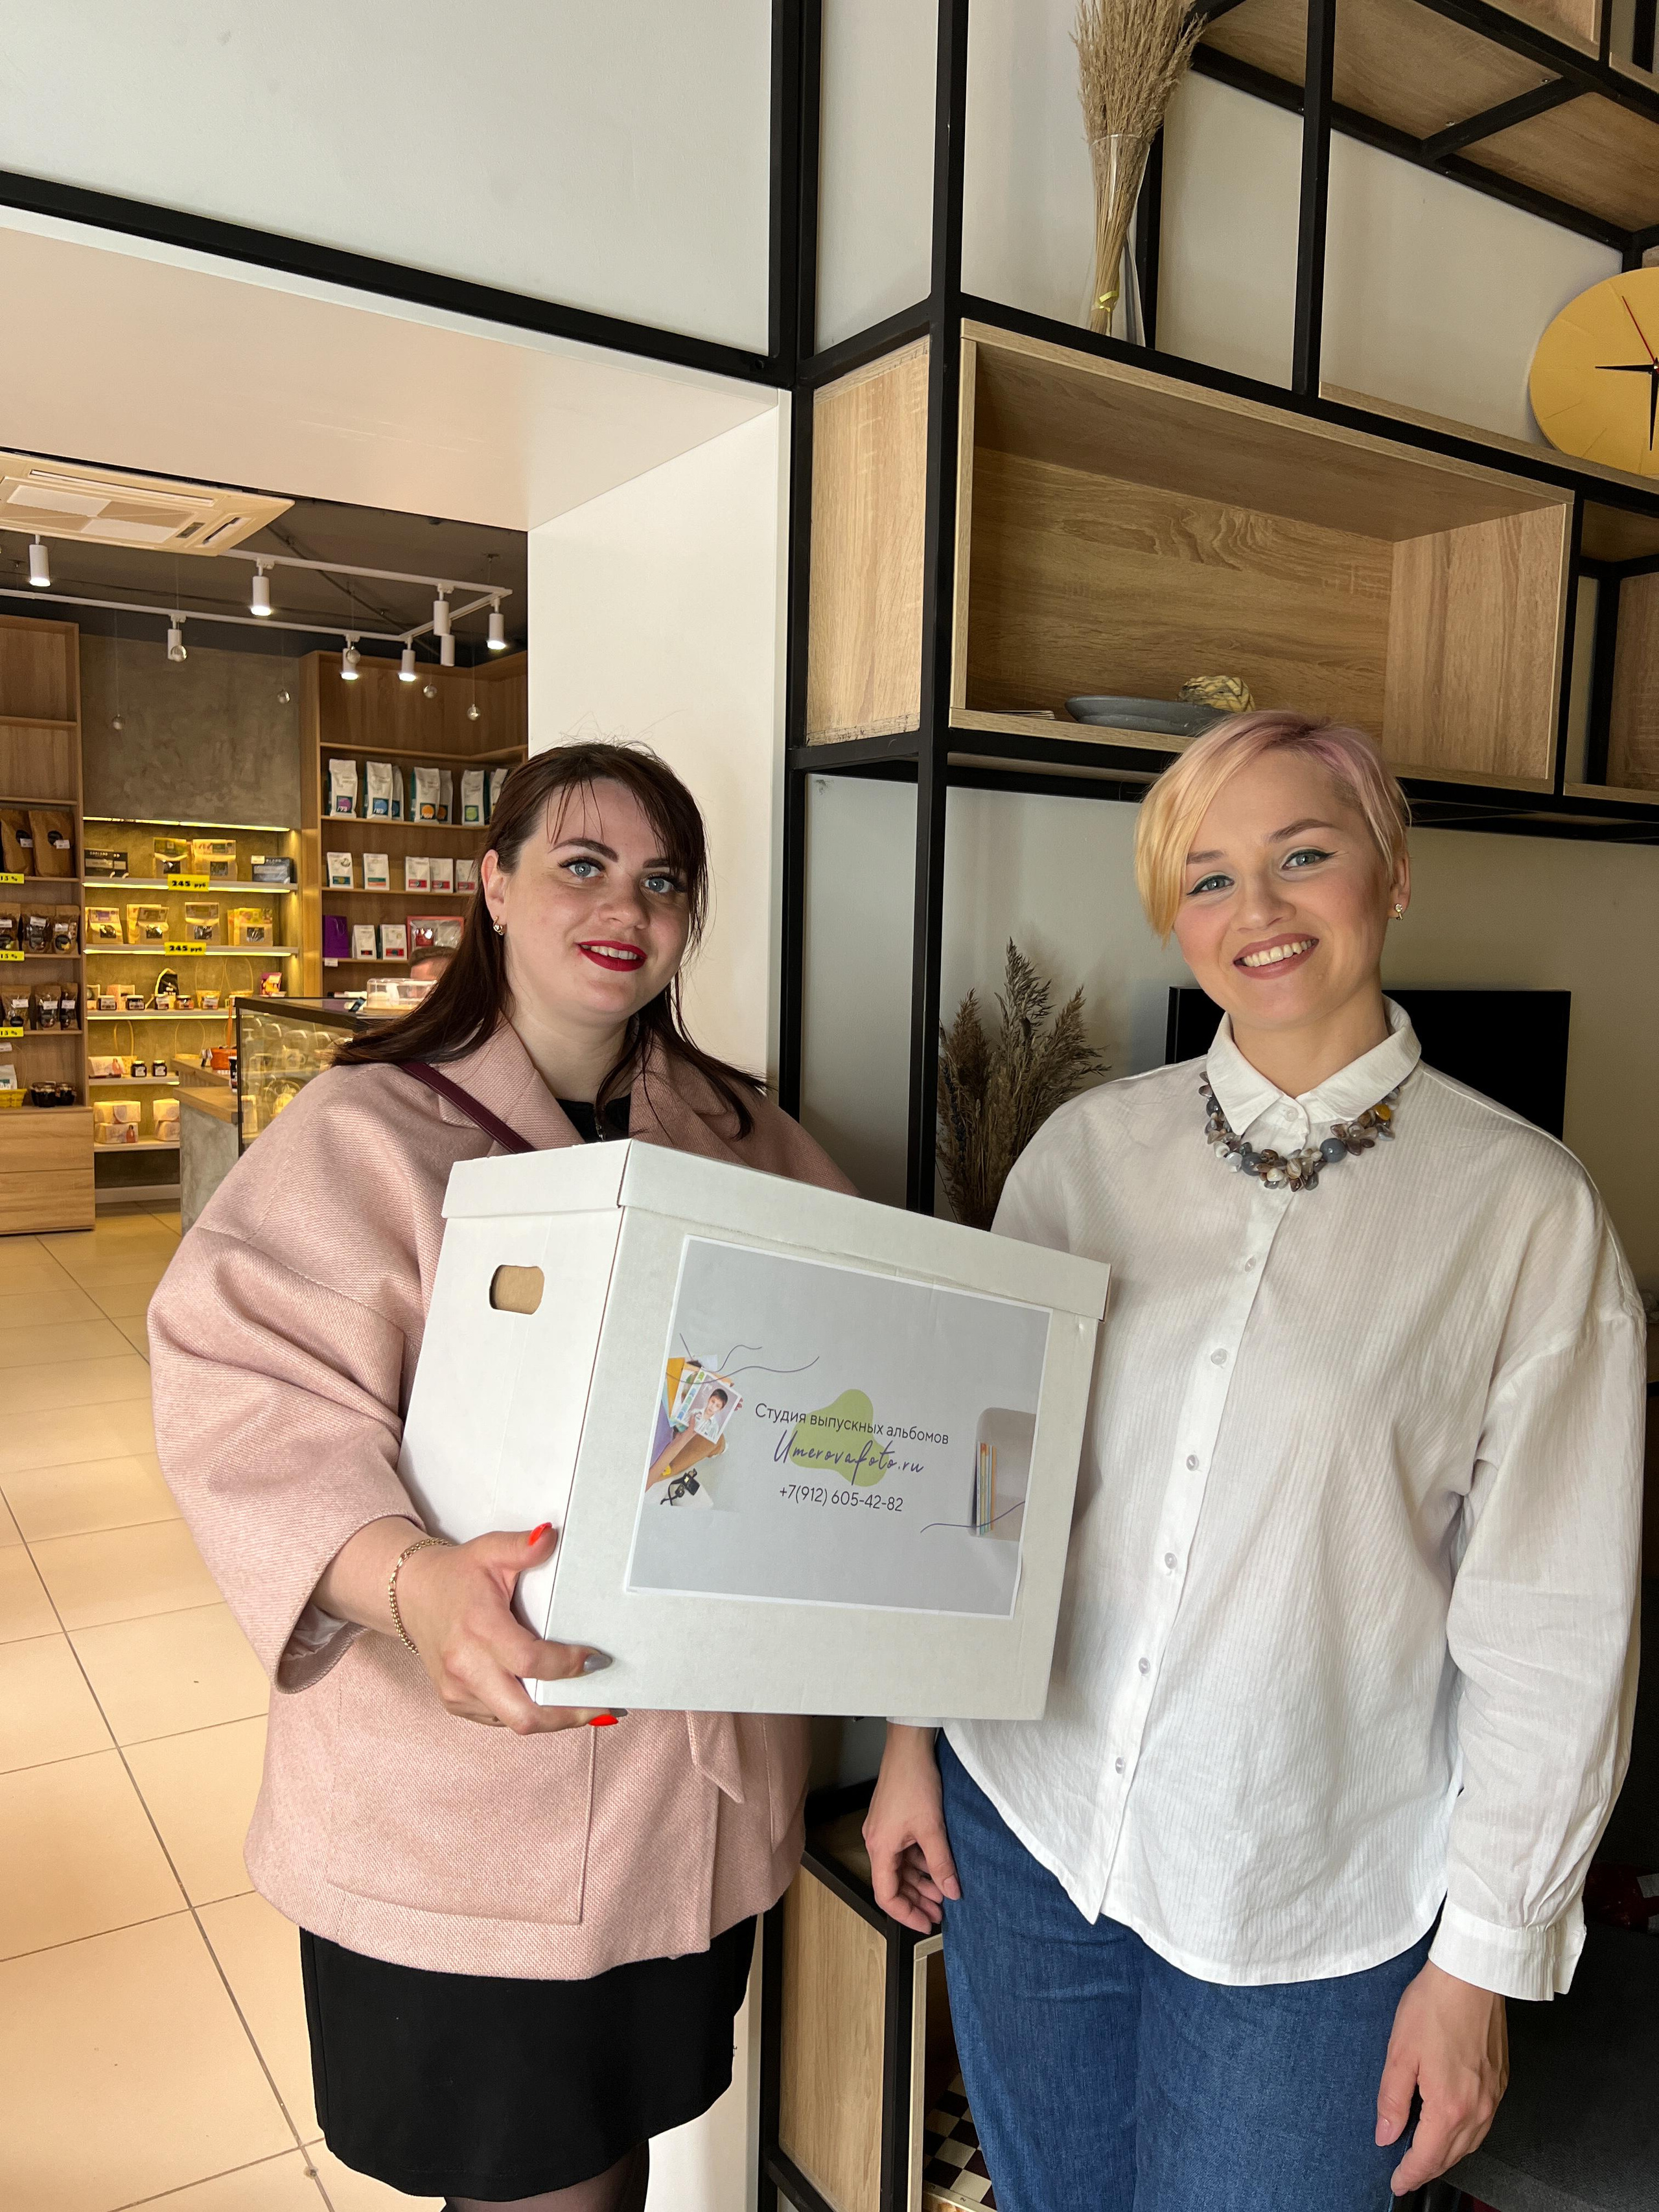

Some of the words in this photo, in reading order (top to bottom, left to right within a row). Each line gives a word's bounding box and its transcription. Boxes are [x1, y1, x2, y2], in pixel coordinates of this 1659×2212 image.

[755, 1403, 806, 1423] Студия
[810, 1415, 883, 1435] выпускных
[887, 1426, 949, 1445] альбомов
[774, 1430, 924, 1485] Umerovafoto.ru
[780, 1484, 828, 1506] +7(912)
[831, 1490, 903, 1511] 605-42-82
